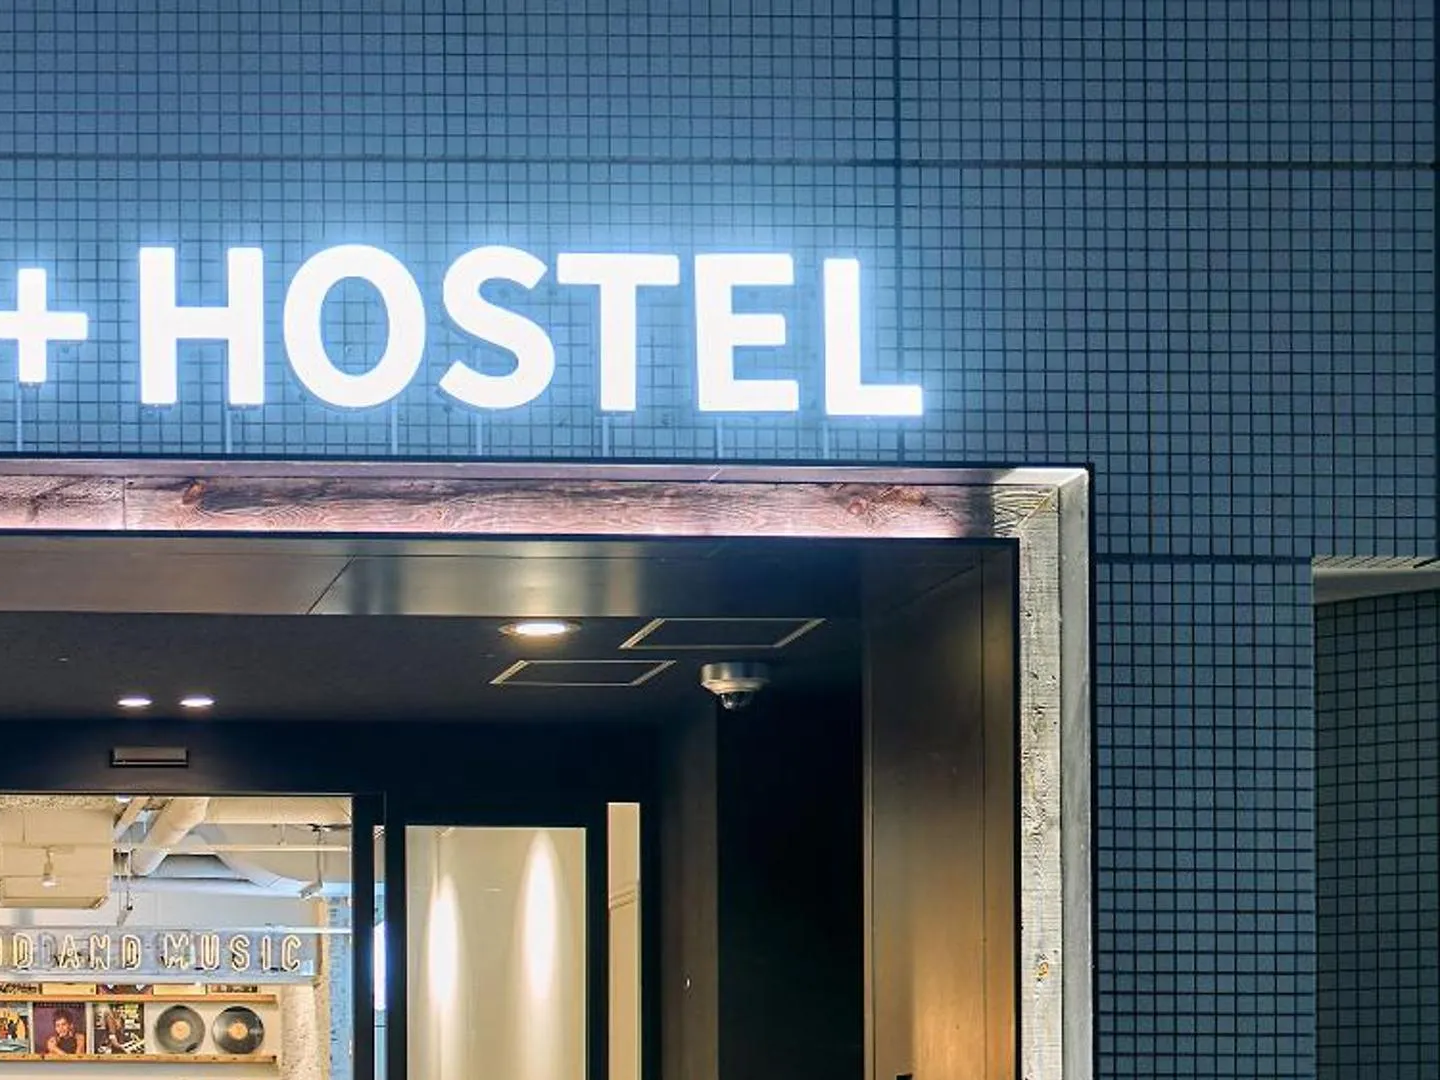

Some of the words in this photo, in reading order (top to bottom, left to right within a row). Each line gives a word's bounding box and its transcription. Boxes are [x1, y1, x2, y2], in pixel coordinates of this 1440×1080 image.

[139, 245, 924, 416] HOSTEL
[59, 934, 141, 970] AND
[163, 934, 303, 972] MUSIC
